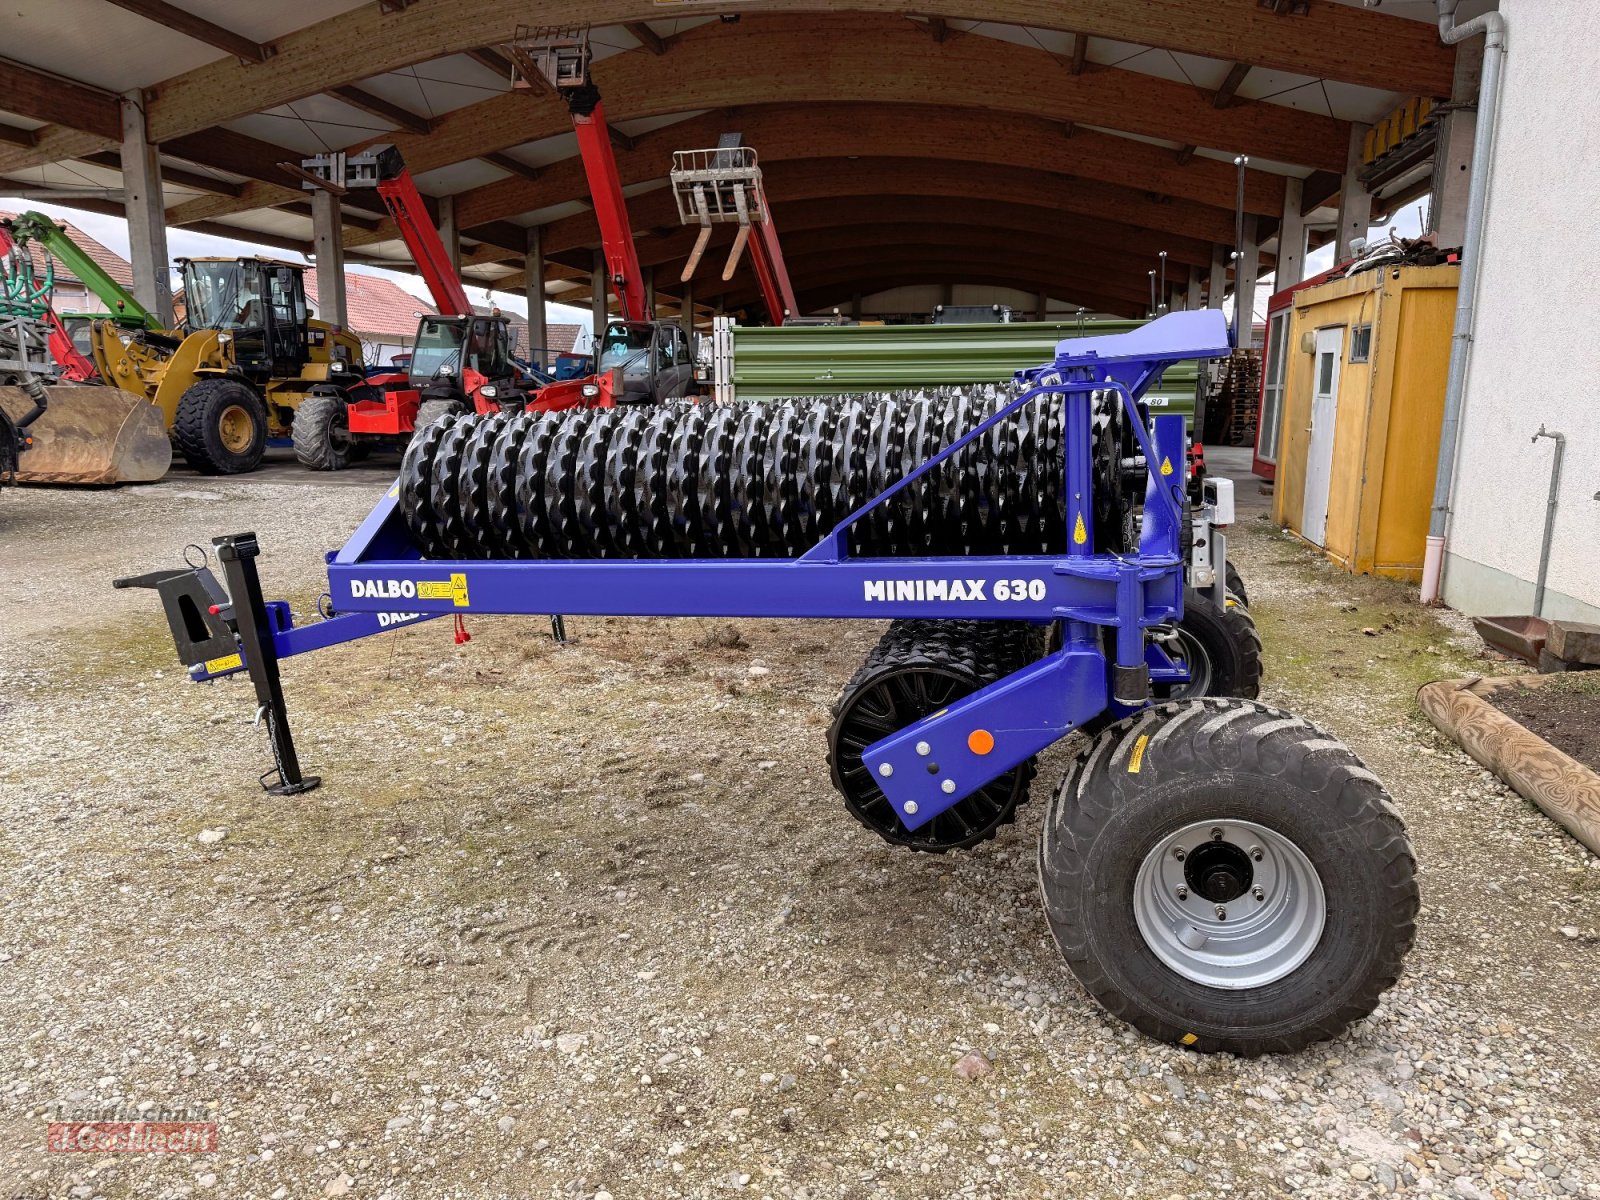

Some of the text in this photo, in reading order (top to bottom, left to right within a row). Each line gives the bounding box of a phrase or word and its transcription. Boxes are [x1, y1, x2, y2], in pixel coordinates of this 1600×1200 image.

[350, 579, 416, 598] DALBO
[863, 578, 1047, 602] MINIMAX 630
